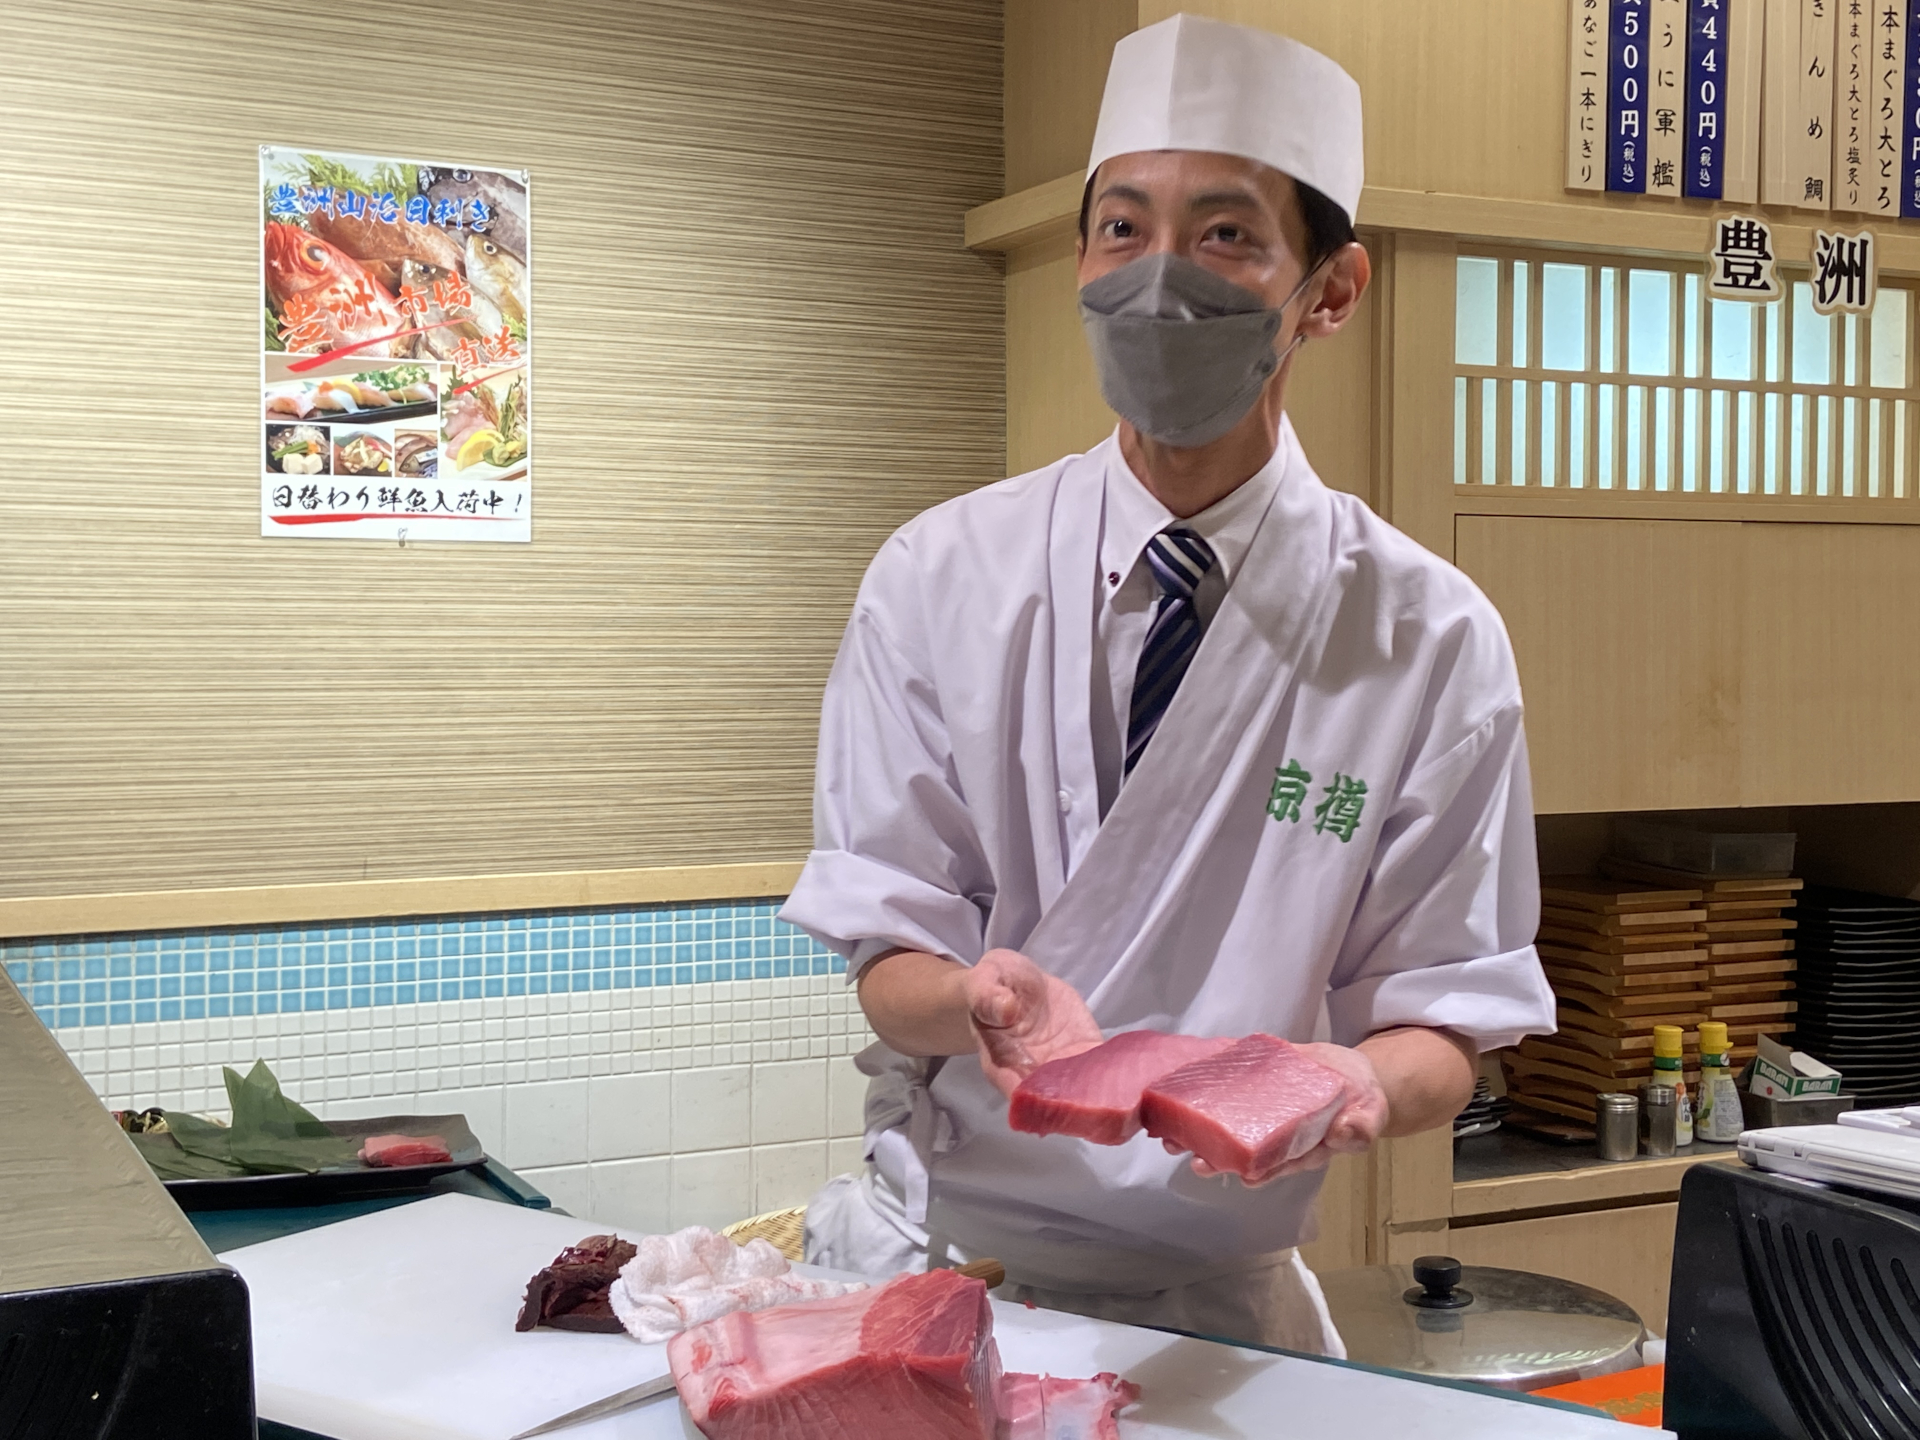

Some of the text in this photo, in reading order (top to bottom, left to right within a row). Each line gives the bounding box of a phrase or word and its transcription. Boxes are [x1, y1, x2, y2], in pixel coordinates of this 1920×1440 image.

[1620, 0, 1641, 183] 500円(税込)
[1652, 0, 1681, 188] うに軍艦
[1804, 0, 1825, 202] きんめ鯛
[1846, 0, 1862, 205] 本まぐろ大とろ塩炙り
[1877, 5, 1900, 210] 本まぐろ大とろ
[269, 183, 491, 231] 豊洲山治目利き
[1714, 219, 1869, 306] 豊洲
[278, 271, 472, 353] 豊洲市場
[451, 325, 521, 377] 直送
[273, 484, 523, 515] 日替わり鮮魚入荷中!
[1266, 758, 1368, 843] 京樽
[1760, 1061, 1789, 1088] BARAN
[1802, 1080, 1833, 1092] BARAN
